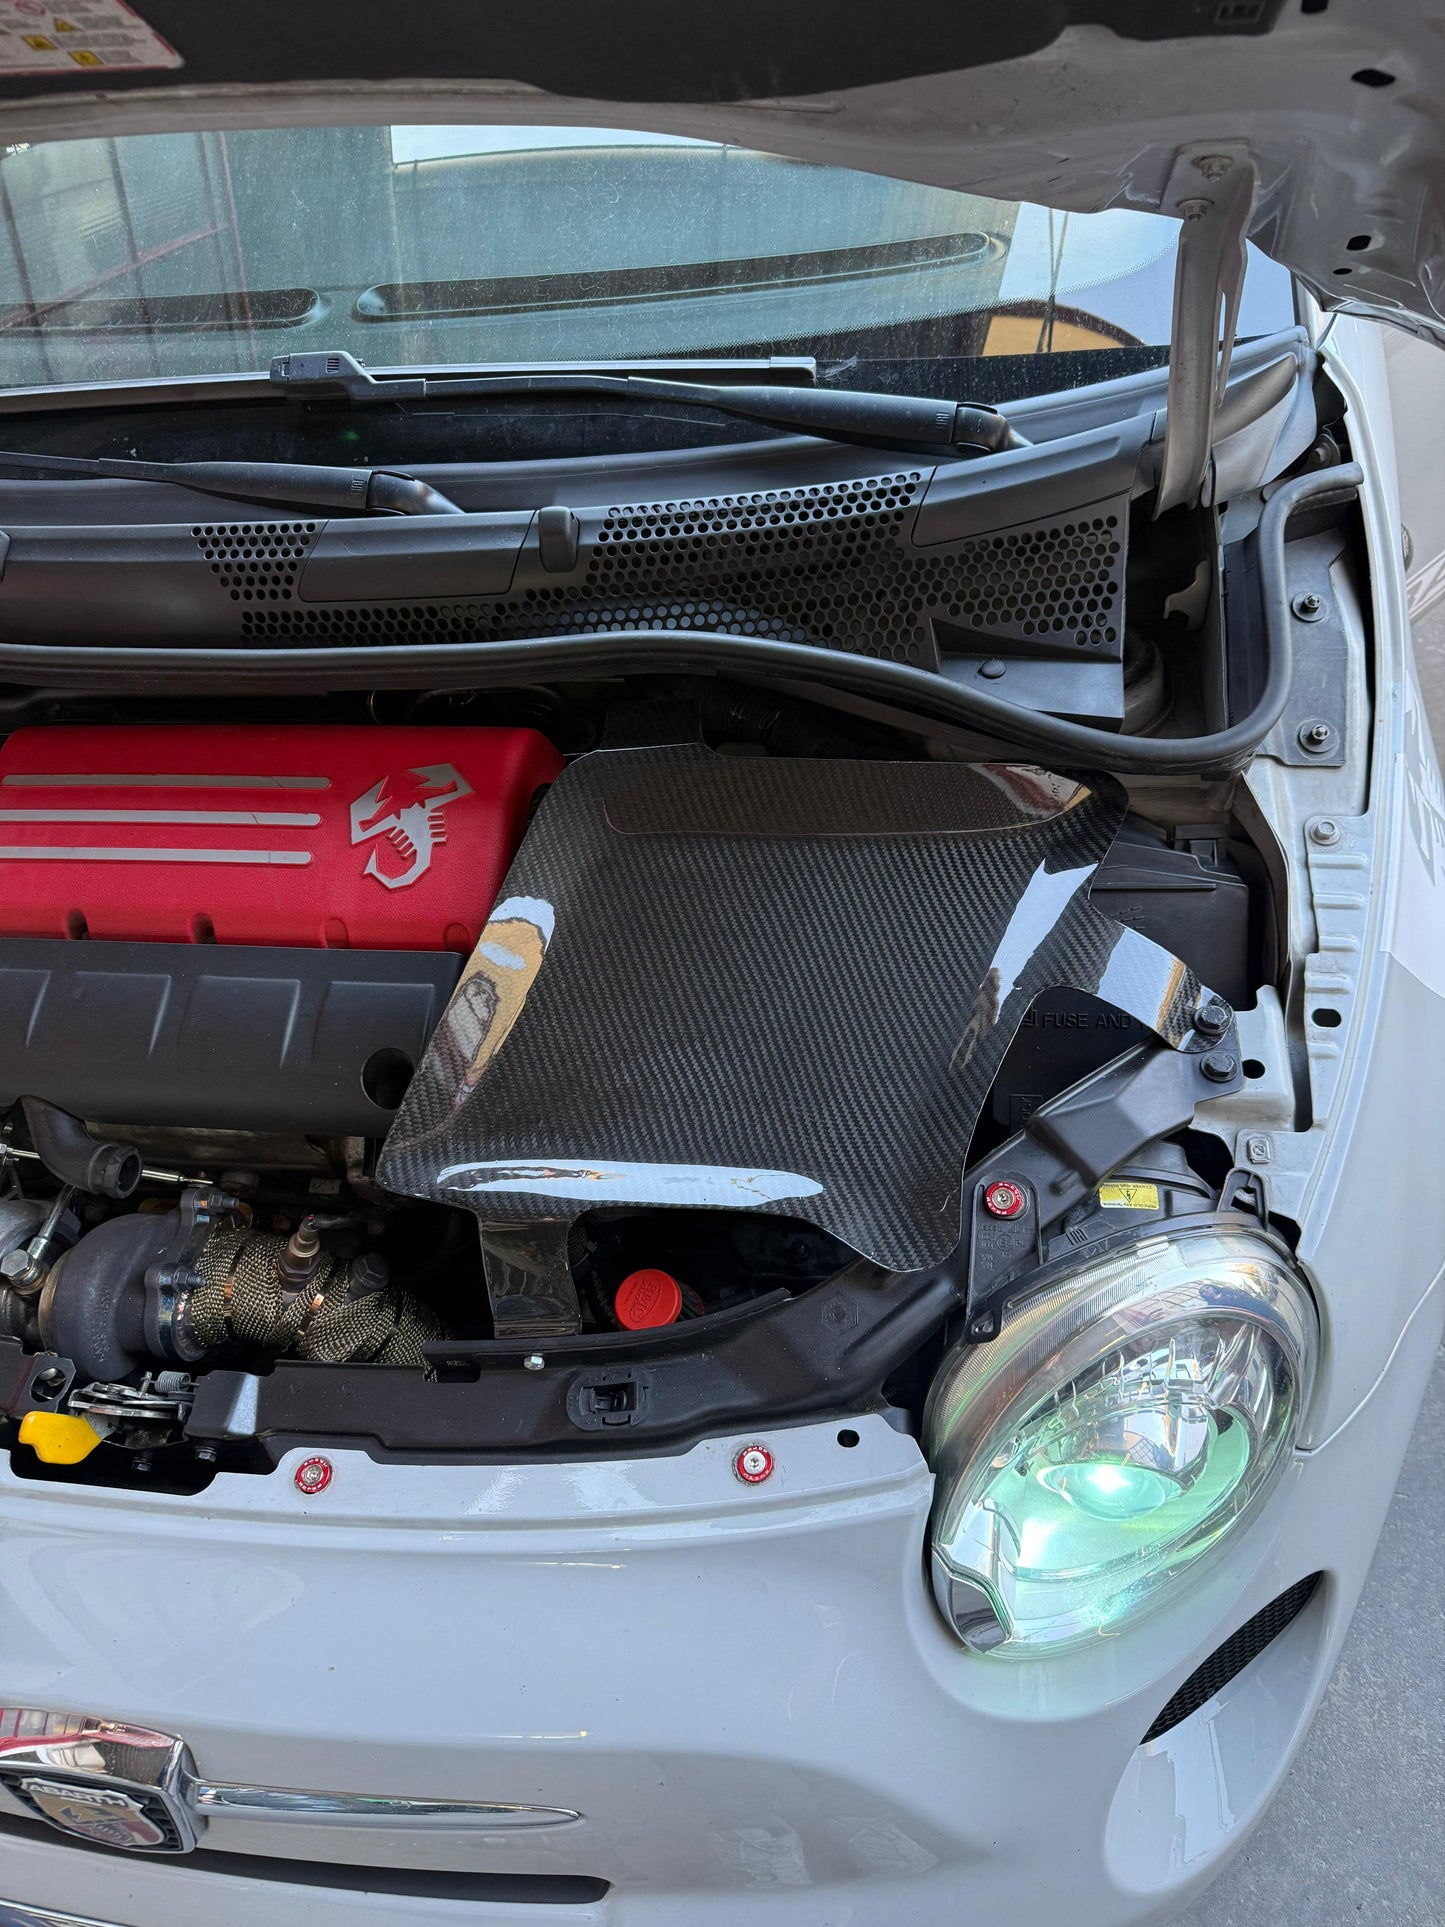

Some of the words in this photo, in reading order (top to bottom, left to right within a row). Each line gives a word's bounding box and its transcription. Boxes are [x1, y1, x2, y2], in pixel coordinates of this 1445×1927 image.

[1043, 1012, 1089, 1028] FUSE
[1095, 1013, 1133, 1029] AND
[29, 1784, 126, 1807] ABARTH
